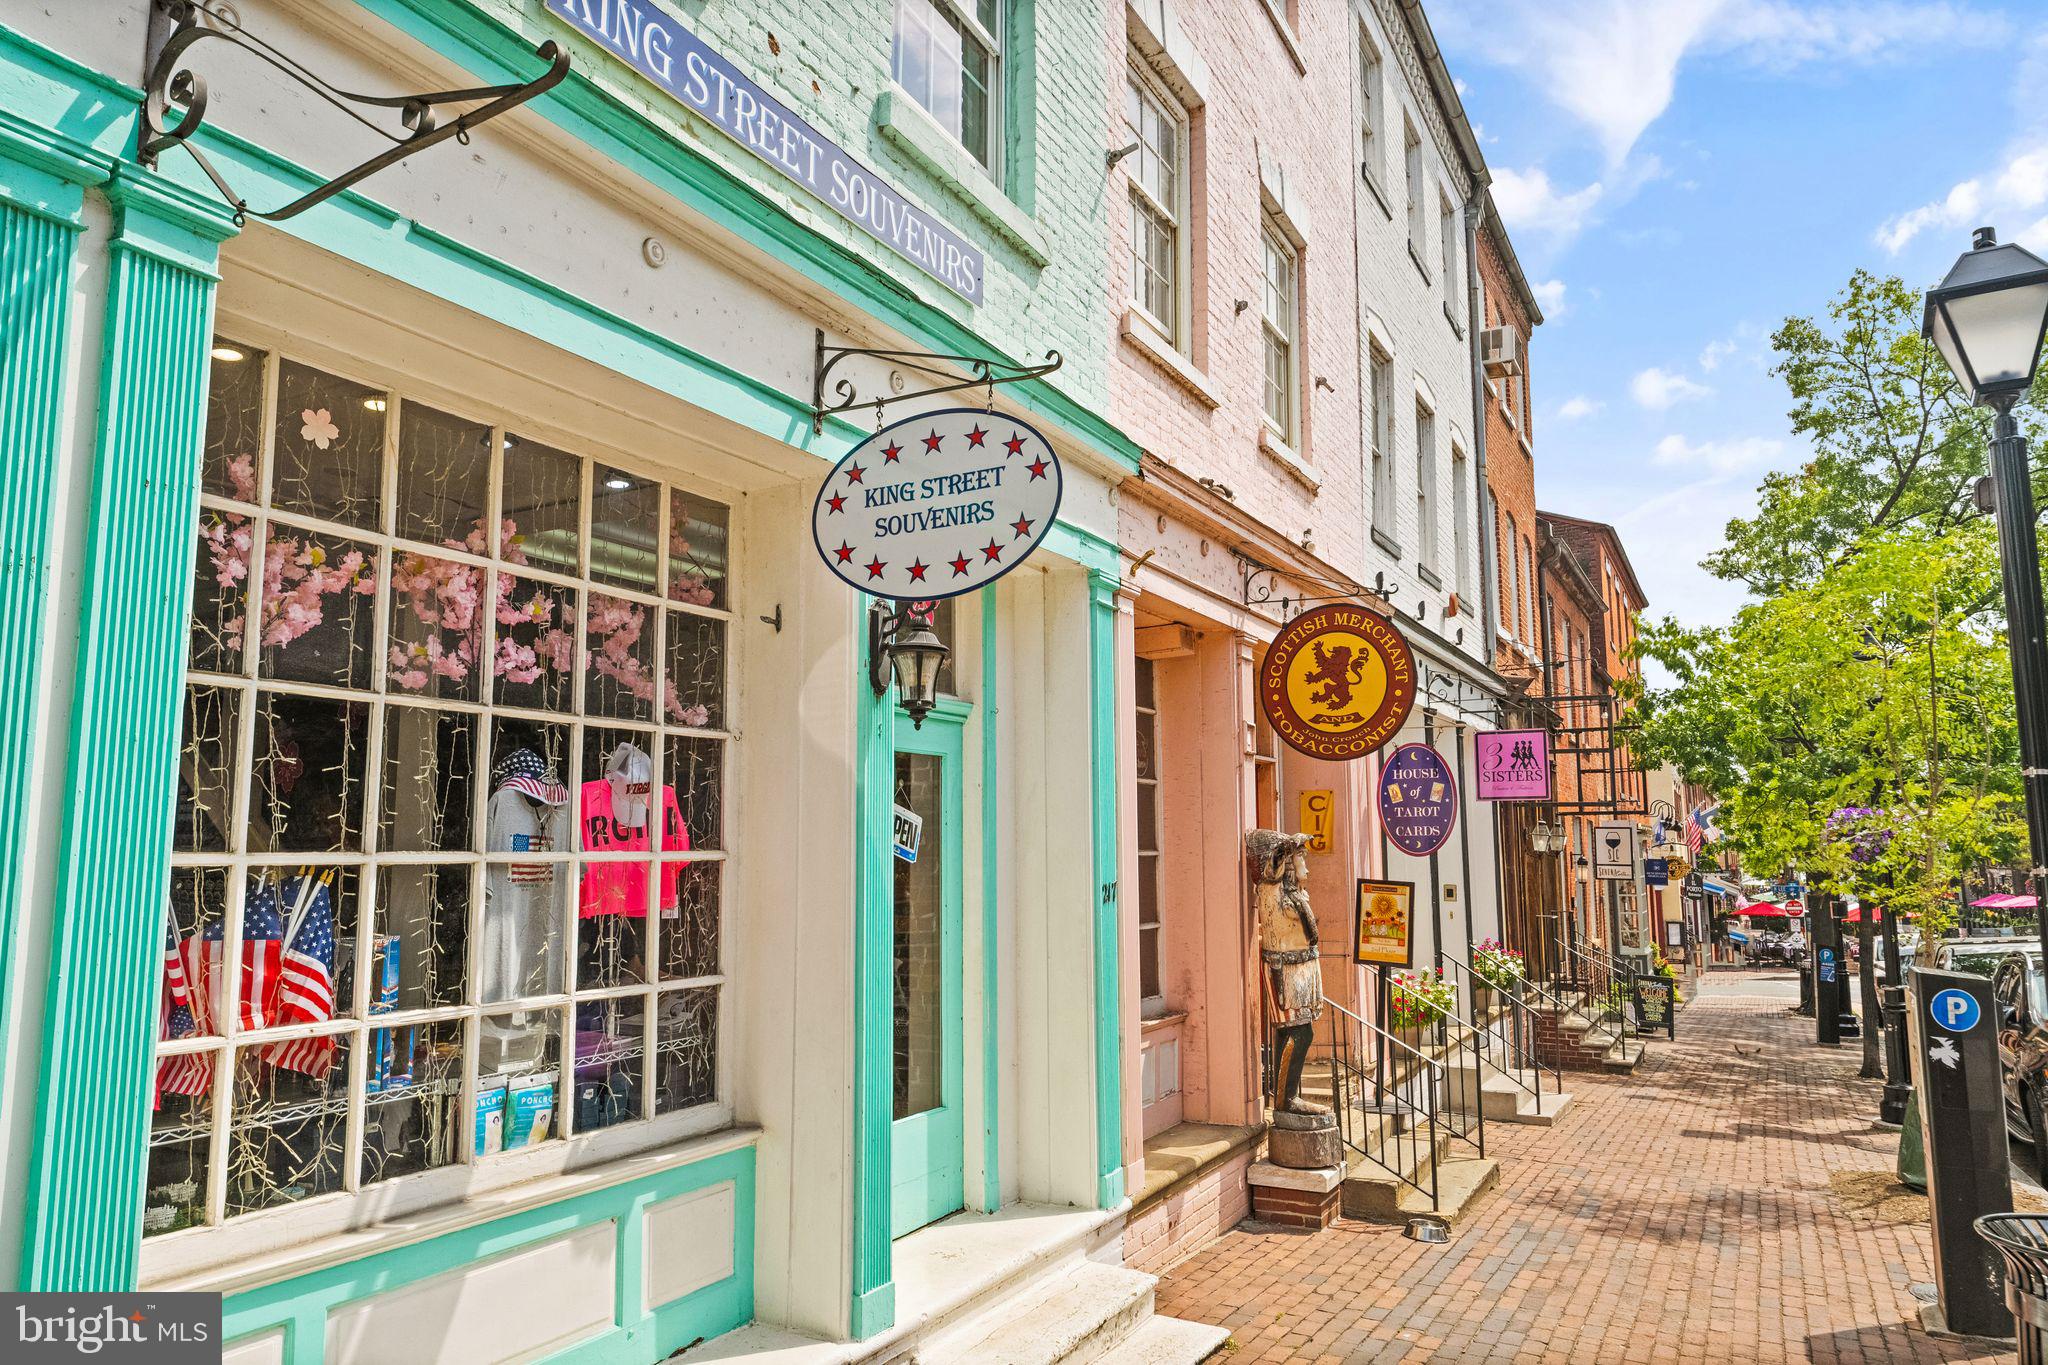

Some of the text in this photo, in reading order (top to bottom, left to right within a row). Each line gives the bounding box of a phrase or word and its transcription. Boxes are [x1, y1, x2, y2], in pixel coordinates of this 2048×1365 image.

[684, 52, 823, 186] STREET
[830, 160, 976, 294] SOUVENIRS
[864, 466, 1006, 508] KING STREET
[874, 500, 995, 537] SOUVENIRS
[1269, 612, 1409, 688] SCOTTISH MERCHANT
[1273, 702, 1404, 755] TOBACCONIST
[1319, 715, 1355, 723] AND
[1302, 727, 1371, 743] John Crouch
[1482, 742, 1503, 770] 3
[1392, 768, 1439, 779] HOUSE
[1482, 769, 1543, 783] SISTERS
[1410, 786, 1422, 799] of
[1394, 806, 1440, 818] TAROT
[894, 814, 918, 850] PEN
[1395, 825, 1441, 837] CARDS
[1946, 996, 1968, 1024] P
